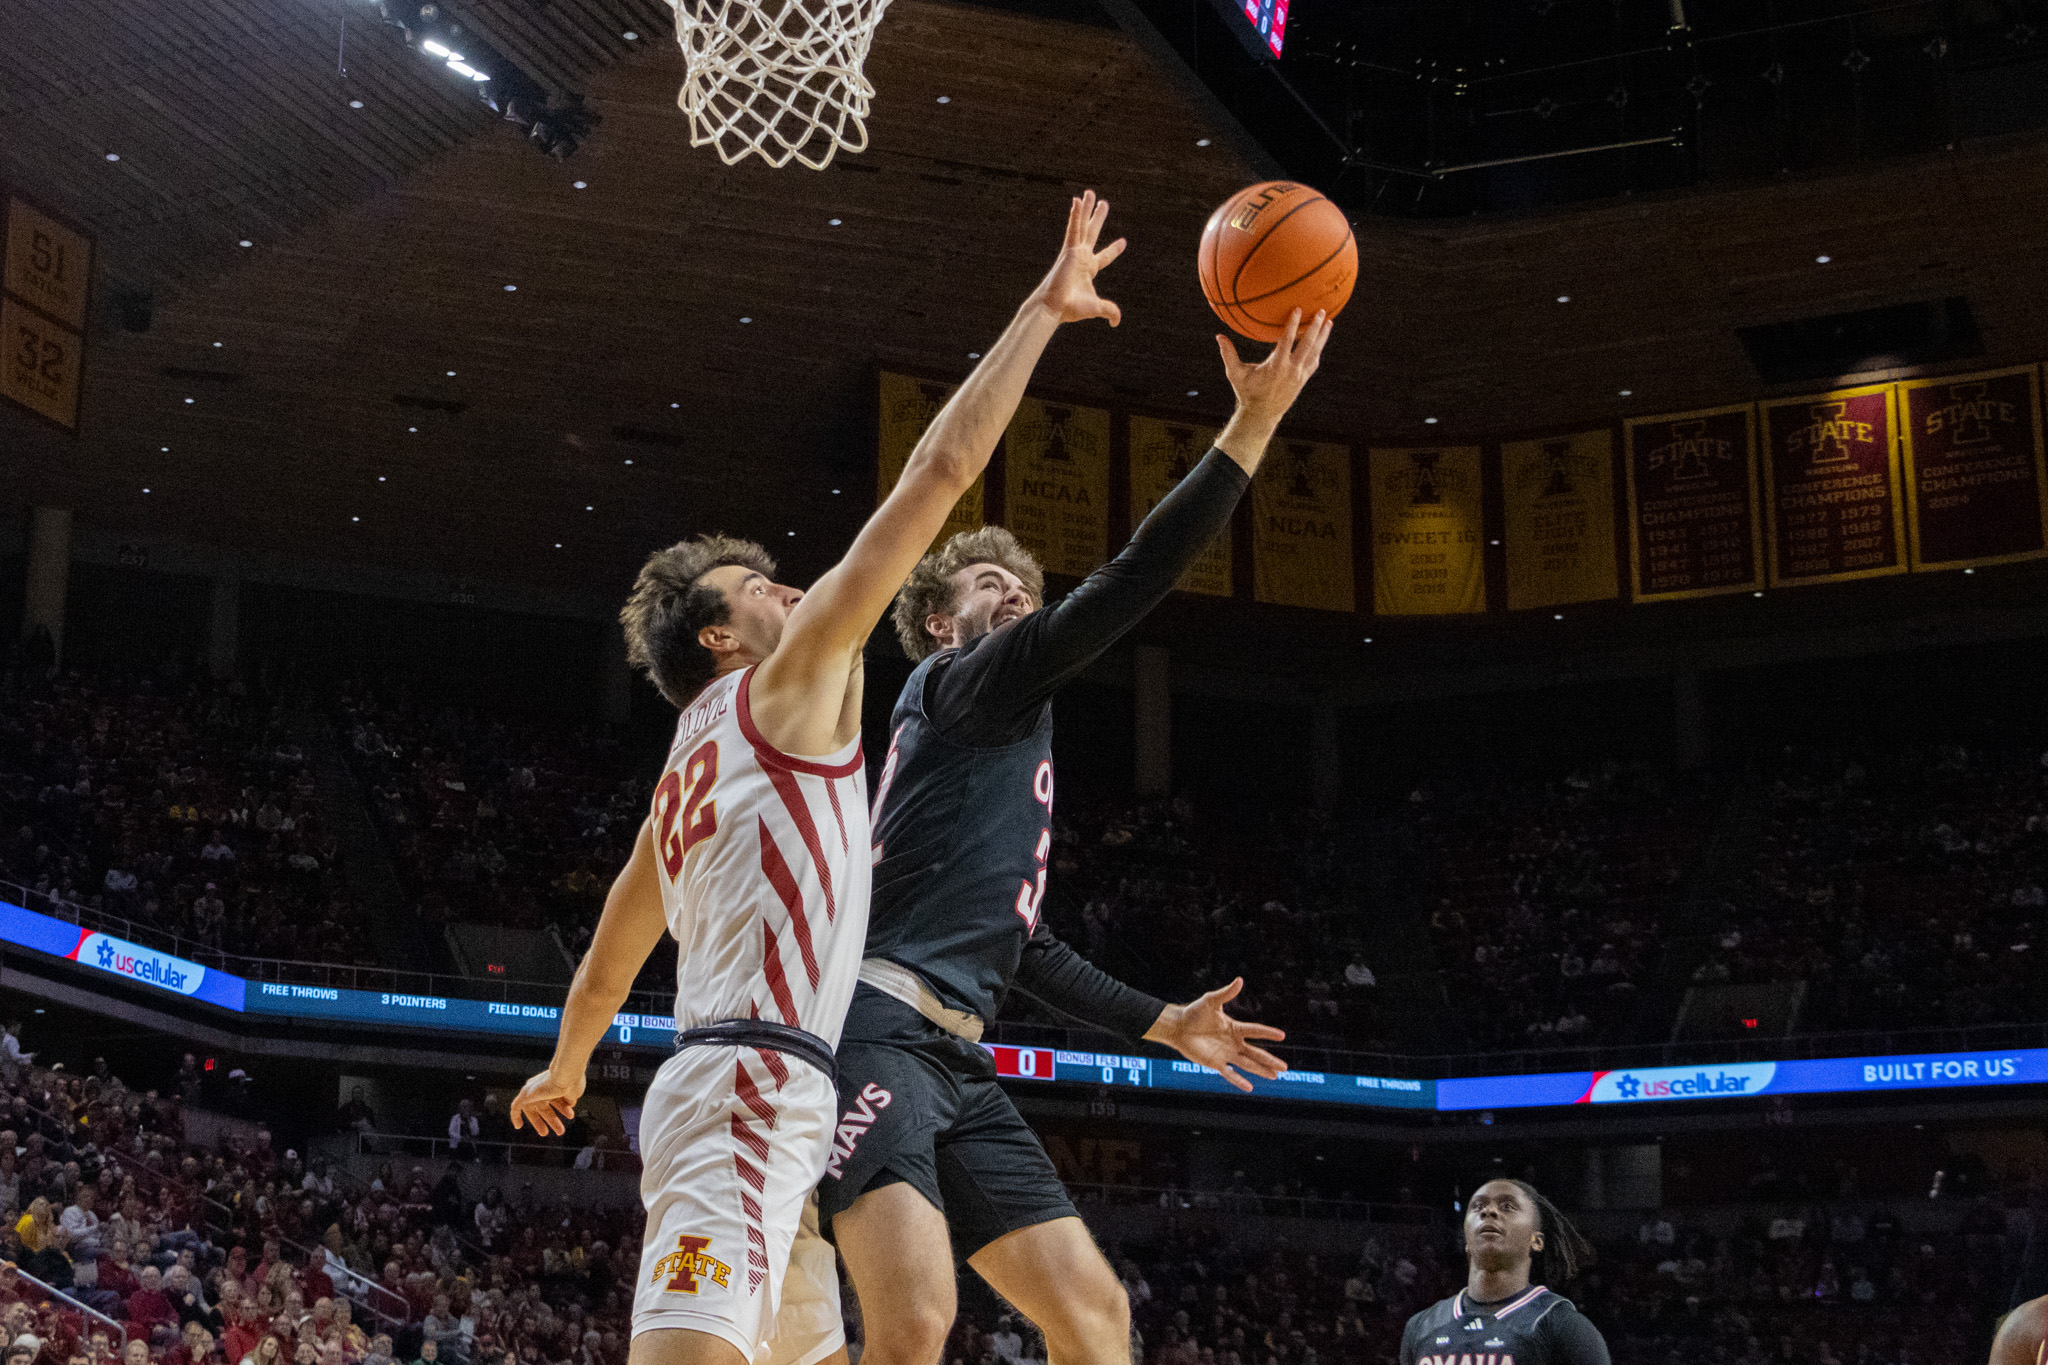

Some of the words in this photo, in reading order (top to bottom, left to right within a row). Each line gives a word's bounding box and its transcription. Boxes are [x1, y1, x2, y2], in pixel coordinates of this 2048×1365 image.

[31, 228, 66, 283] 51
[17, 325, 64, 385] 32
[1926, 400, 2017, 434] STATE
[1787, 420, 1874, 454] STATE
[1648, 437, 1733, 471] STATE
[1922, 454, 2026, 478] CONFERENCE
[1782, 473, 1883, 495] CONFERENCE
[1921, 467, 2031, 492] CHAMPIONS
[1022, 479, 1091, 507] NCAA
[1643, 491, 1741, 512] CONFERENCE
[1781, 485, 1886, 510] CHAMPIONS
[1642, 502, 1744, 525] CHAMPIONS
[1840, 504, 1882, 520] 1979
[1269, 516, 1337, 540] NCAA
[1379, 531, 1451, 545] SWEET
[1457, 530, 1476, 544] 16
[1840, 520, 1882, 536] 1982
[654, 739, 719, 885] 22
[115, 953, 188, 990] uscellular
[262, 984, 289, 997] FREE
[291, 986, 339, 1001] THROWS
[381, 993, 390, 1005] 3
[391, 994, 447, 1010] POINTERS
[488, 1002, 520, 1016] FIELD
[522, 1006, 557, 1019] GOALS
[617, 1015, 636, 1025] FLS
[620, 1026, 631, 1043] 0
[602, 1064, 631, 1079] 138
[1018, 1049, 1036, 1077] 0
[1059, 1053, 1093, 1065] BONUS
[1099, 1056, 1117, 1067] FLS
[1126, 1059, 1143, 1069] TOL
[1172, 1061, 1201, 1073] FIELD
[1863, 1062, 1925, 1083] BUILT
[1931, 1060, 1979, 1080] FOR
[1985, 1058, 2015, 1077] US
[1102, 1066, 1113, 1084] 0
[1128, 1069, 1140, 1085] 4
[1277, 1070, 1325, 1084] POINTERS
[1356, 1076, 1380, 1089] FREE
[1381, 1078, 1421, 1091] THROWS
[1644, 1071, 1750, 1096] uscellular
[825, 1082, 892, 1181] MAVS
[651, 1251, 732, 1289] STATE
